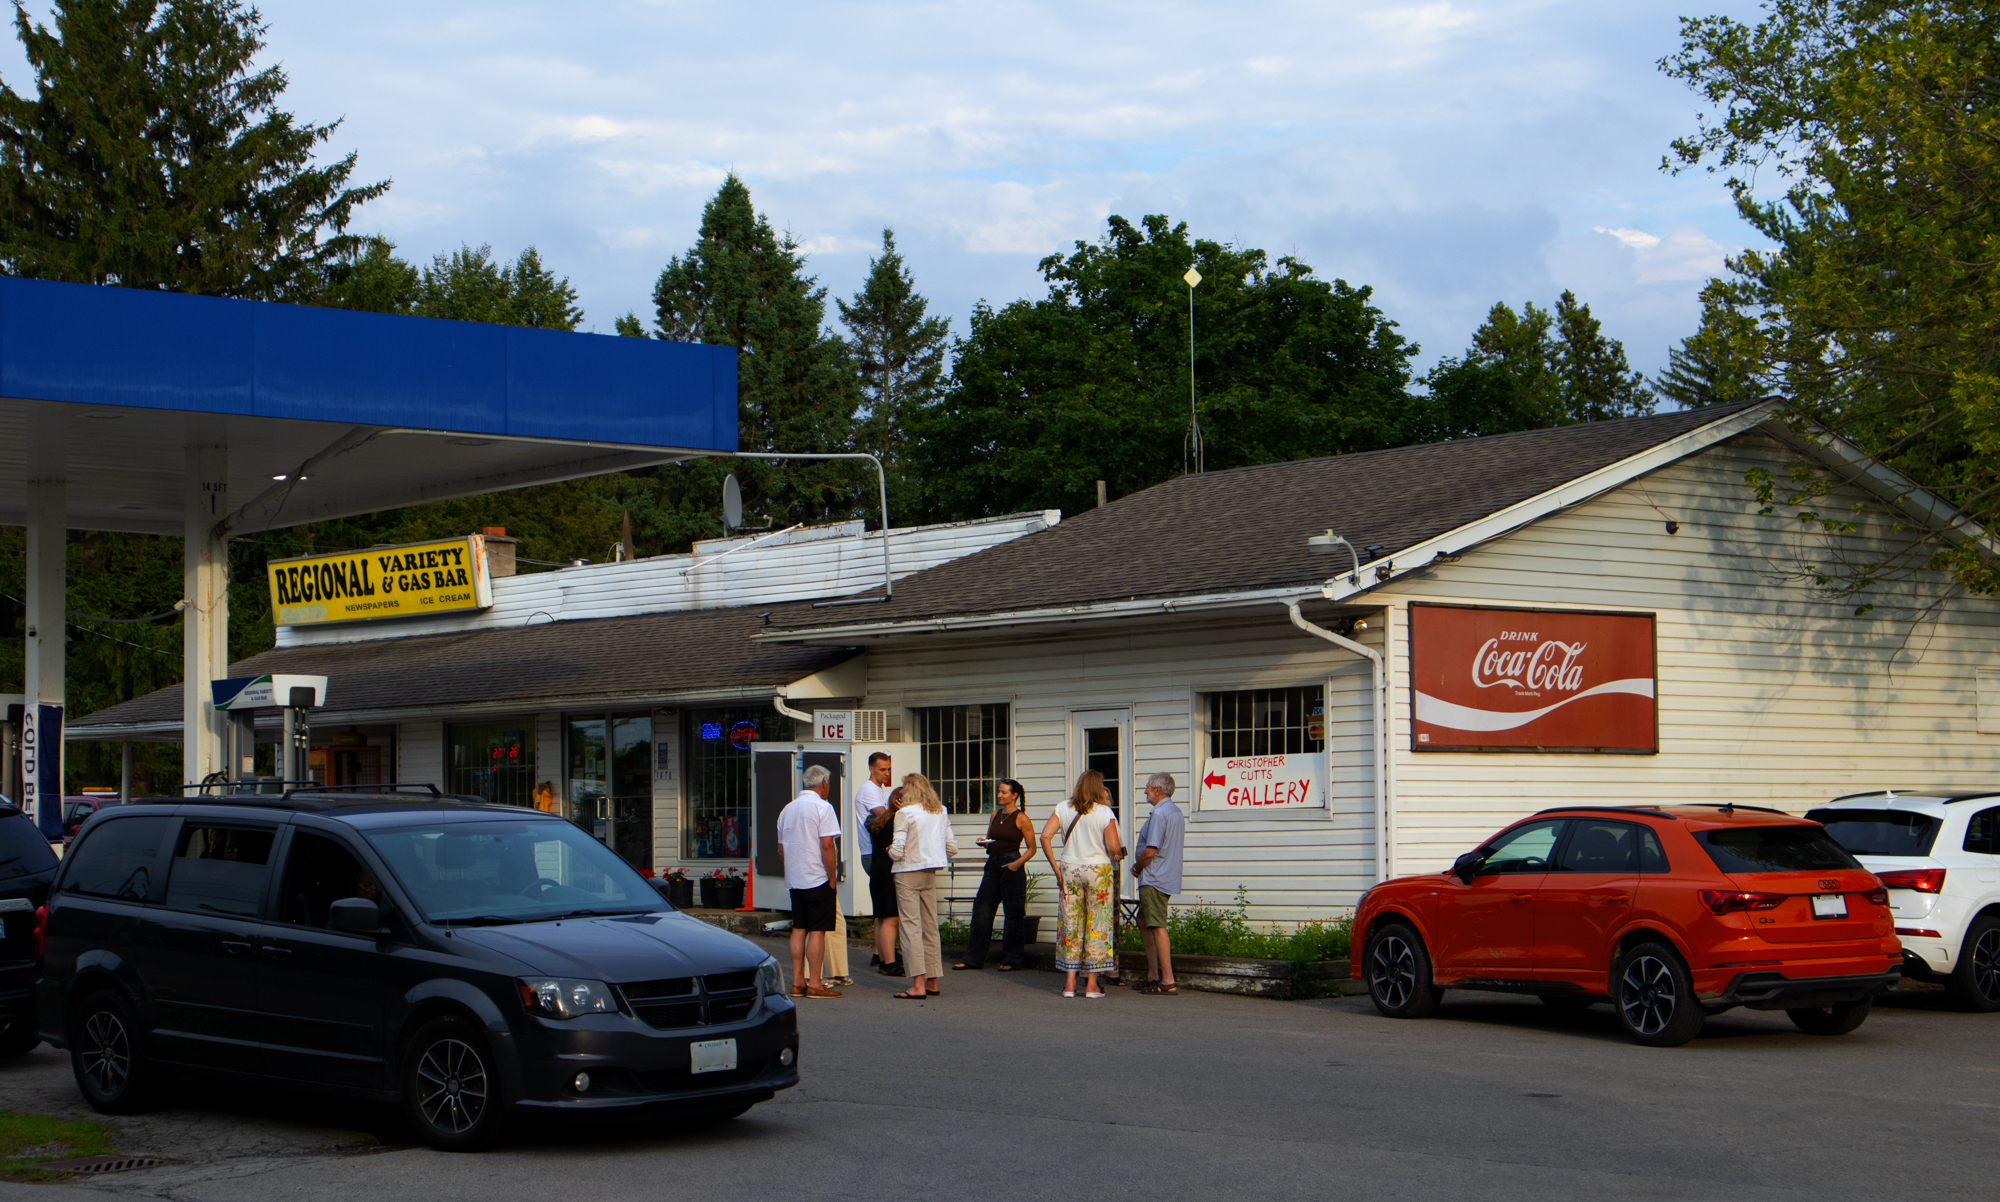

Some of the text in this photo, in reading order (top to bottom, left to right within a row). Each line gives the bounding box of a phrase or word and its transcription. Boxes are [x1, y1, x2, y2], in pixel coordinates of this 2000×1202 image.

[378, 548, 464, 573] VARIETY
[275, 558, 374, 604] REGIONAL
[382, 568, 468, 593] & GAS BAR
[345, 593, 470, 612] NEWSPAPERS ICE CREAM
[1500, 631, 1539, 642] DRINK
[1472, 638, 1588, 690] Coca-Cola
[702, 723, 722, 731] COLD
[822, 724, 844, 738] ICE
[702, 731, 720, 740] BEER
[730, 728, 756, 743] OPEN
[1227, 756, 1285, 769] CHRISTOPHER
[1240, 770, 1272, 780] CUTTS
[1227, 779, 1310, 806] GALLERY
